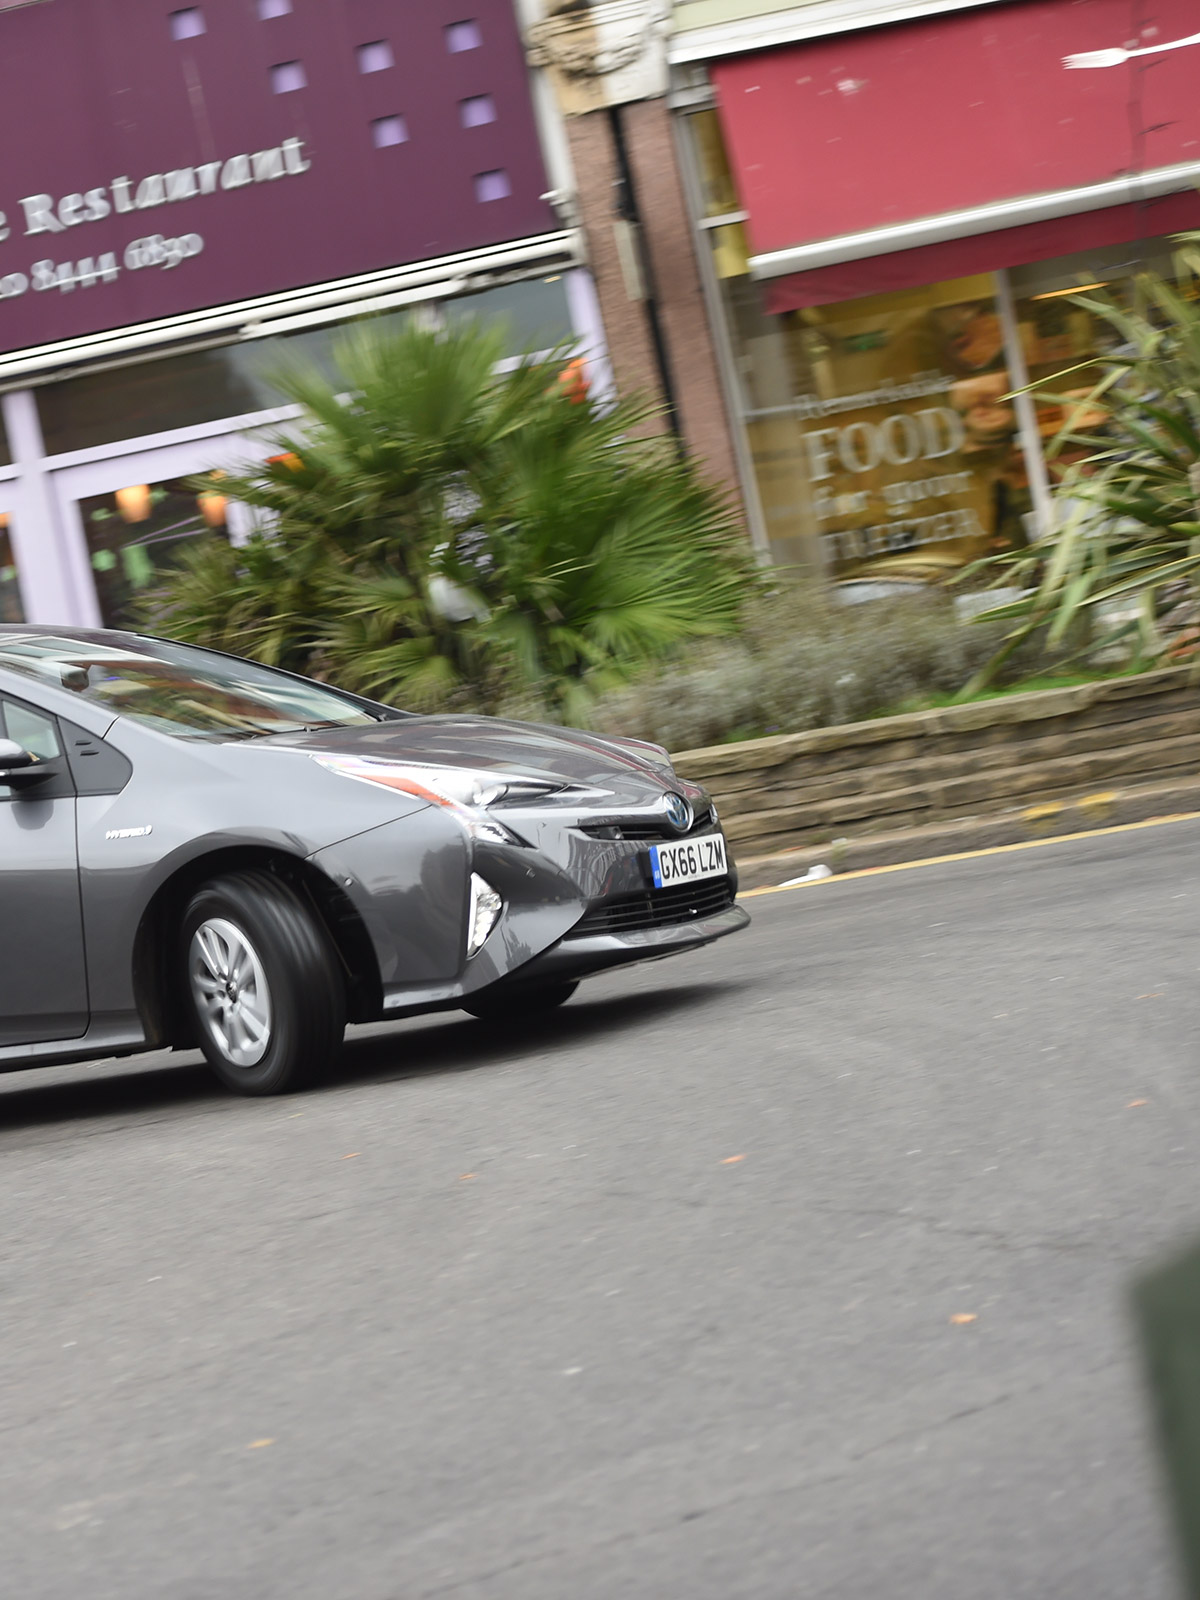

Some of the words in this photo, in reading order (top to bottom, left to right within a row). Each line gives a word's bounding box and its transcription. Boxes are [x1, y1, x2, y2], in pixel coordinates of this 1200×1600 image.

[17, 136, 311, 236] Restaurant
[31, 259, 122, 295] 8444
[800, 406, 967, 483] FOOD
[819, 508, 989, 565] FREEZER
[660, 845, 697, 880] GX66
[697, 840, 725, 872] LZM
